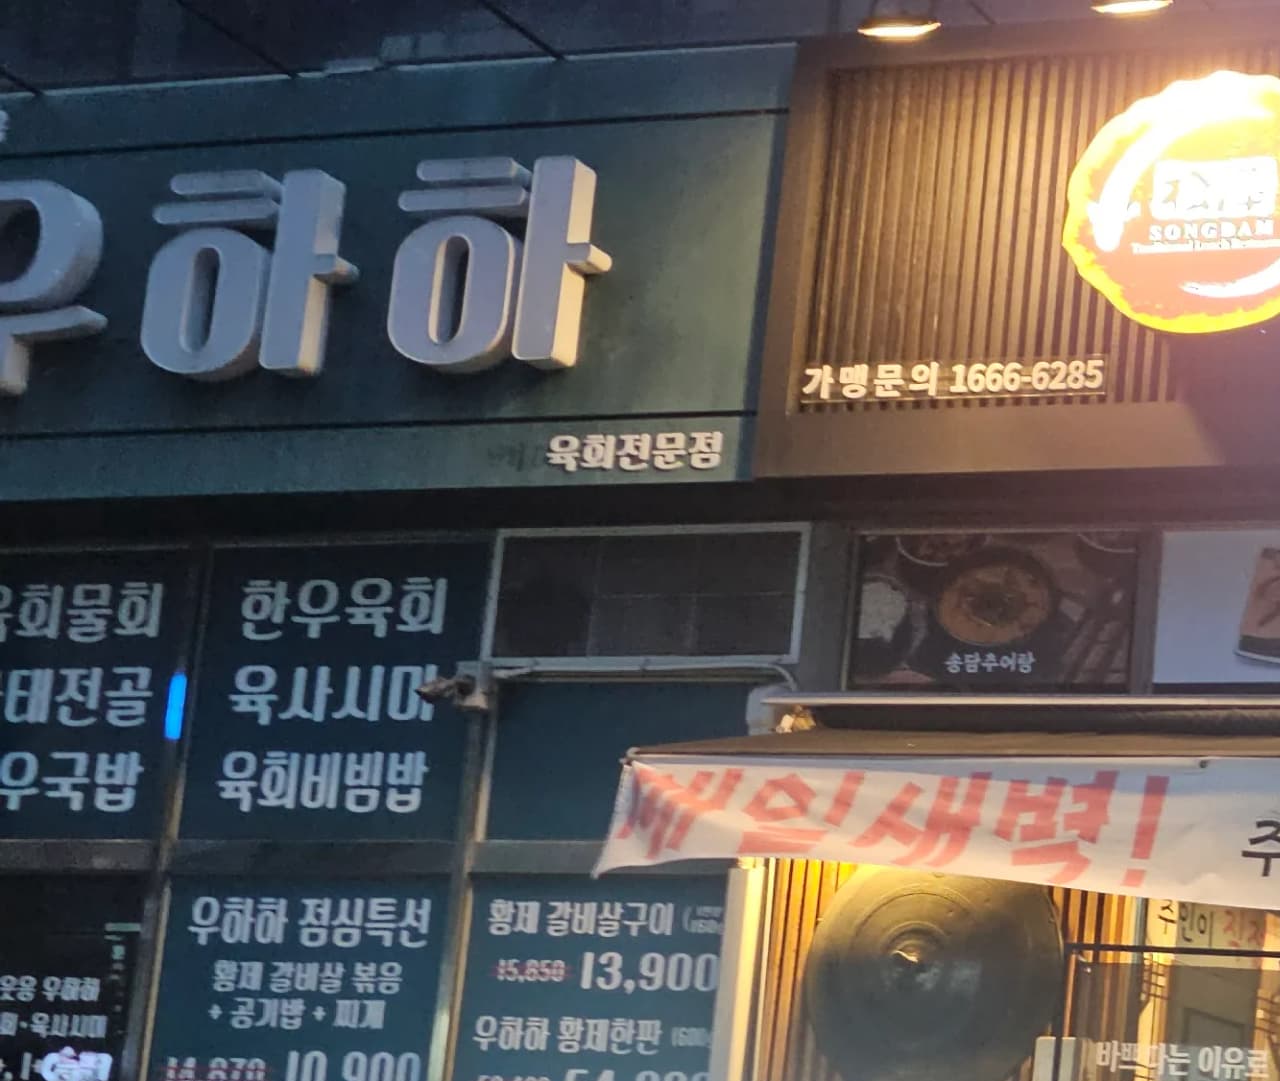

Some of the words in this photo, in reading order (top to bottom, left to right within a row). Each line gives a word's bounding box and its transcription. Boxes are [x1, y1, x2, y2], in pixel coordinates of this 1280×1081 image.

[1150, 217, 1274, 241] SONGDAM
[801, 360, 940, 400] 가맹문의
[949, 358, 1105, 396] 1666-6285
[546, 431, 725, 473] 육회전문점
[0, 581, 164, 644] 회물회
[240, 576, 449, 641] 한우육회
[944, 650, 1037, 674] 송담추어탕
[0, 666, 154, 728] 태전골
[228, 664, 440, 725] 육사시미
[216, 751, 431, 813] 육회비빔밥
[187, 896, 289, 946] 우하하
[298, 897, 432, 948] 점심특선
[488, 898, 541, 936] 황제
[546, 900, 675, 938] 갈비살구이
[212, 959, 265, 992] 황제
[269, 960, 346, 994] 갈비살
[351, 961, 404, 995] 볶음
[579, 951, 721, 995] 13,900
[229, 997, 306, 1030] 공기밥
[332, 999, 387, 1030] 찌개
[472, 1015, 551, 1051] 우하하
[556, 1016, 663, 1056] 황제한판
[1199, 1045, 1269, 1079] 이유로
